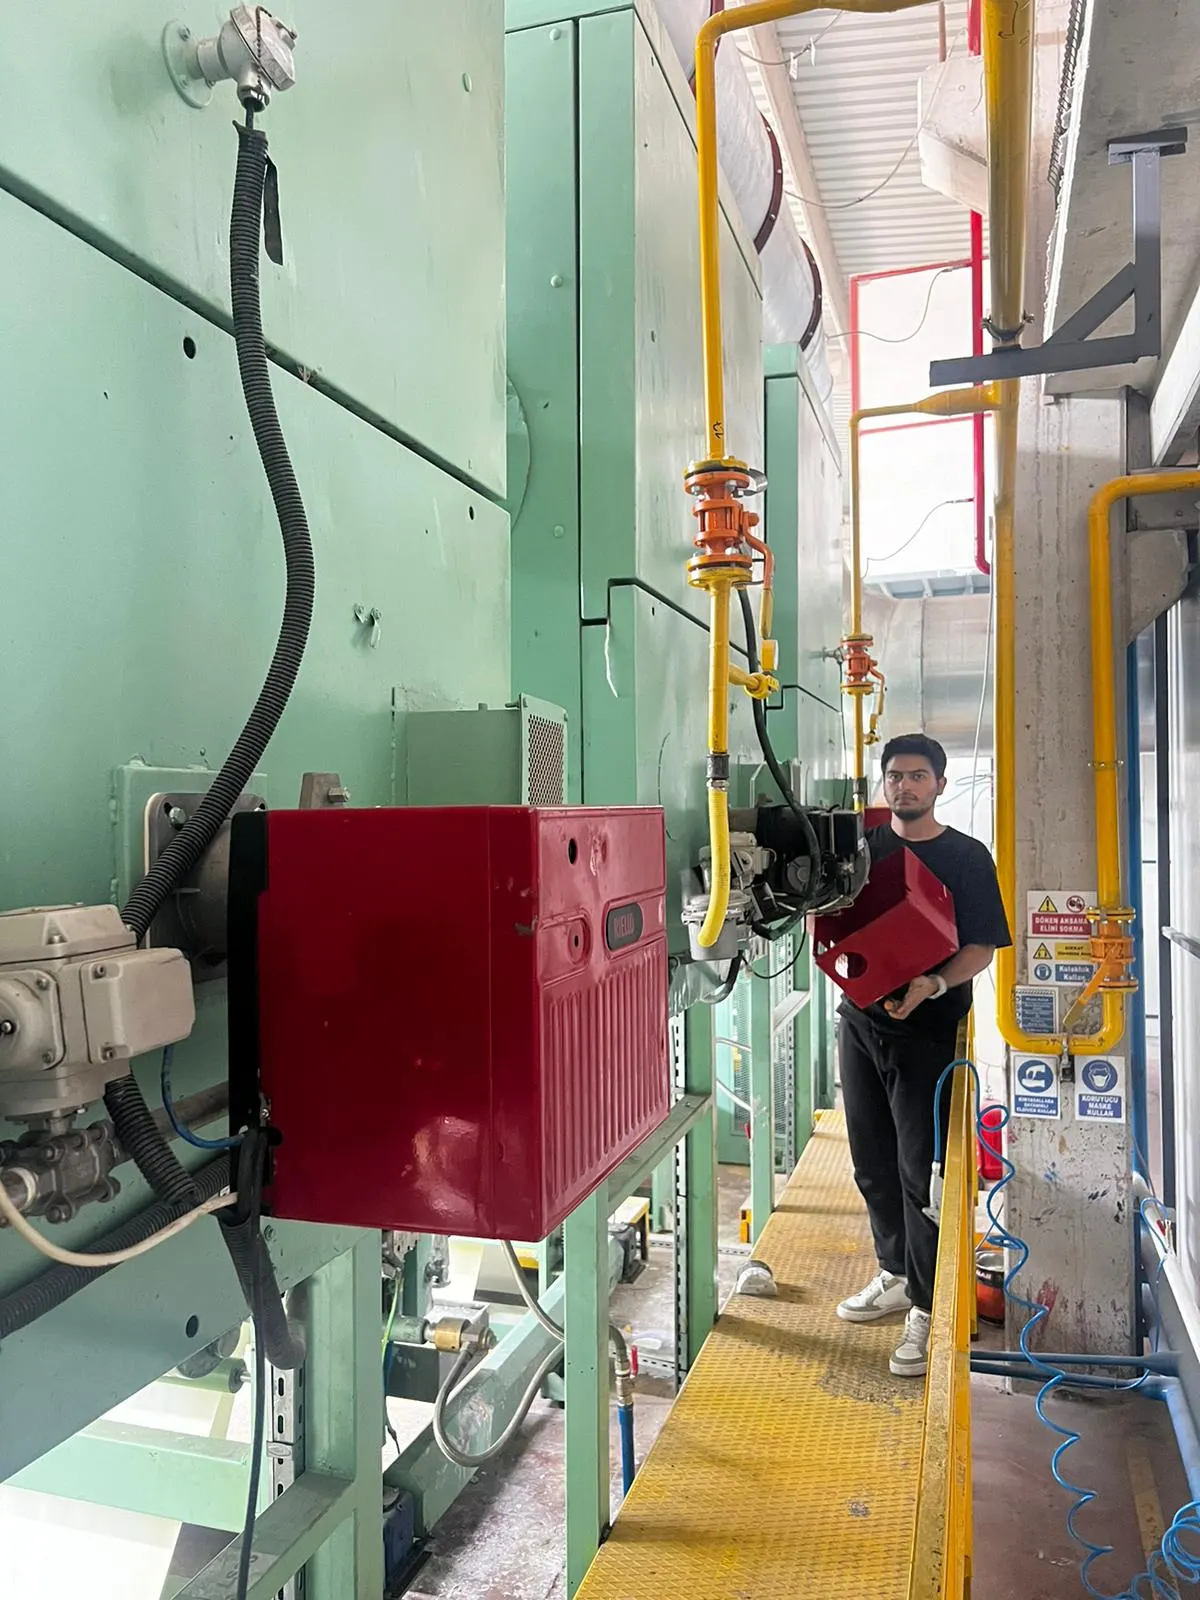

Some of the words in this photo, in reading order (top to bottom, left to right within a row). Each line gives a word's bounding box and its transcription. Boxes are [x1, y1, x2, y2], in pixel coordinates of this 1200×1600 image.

[1035, 916, 1058, 924] DÖNEN
[1040, 924, 1058, 932] ELİNİ
[1081, 1095, 1119, 1103] KORUYUCU
[1087, 1109, 1114, 1117] KULLAN
